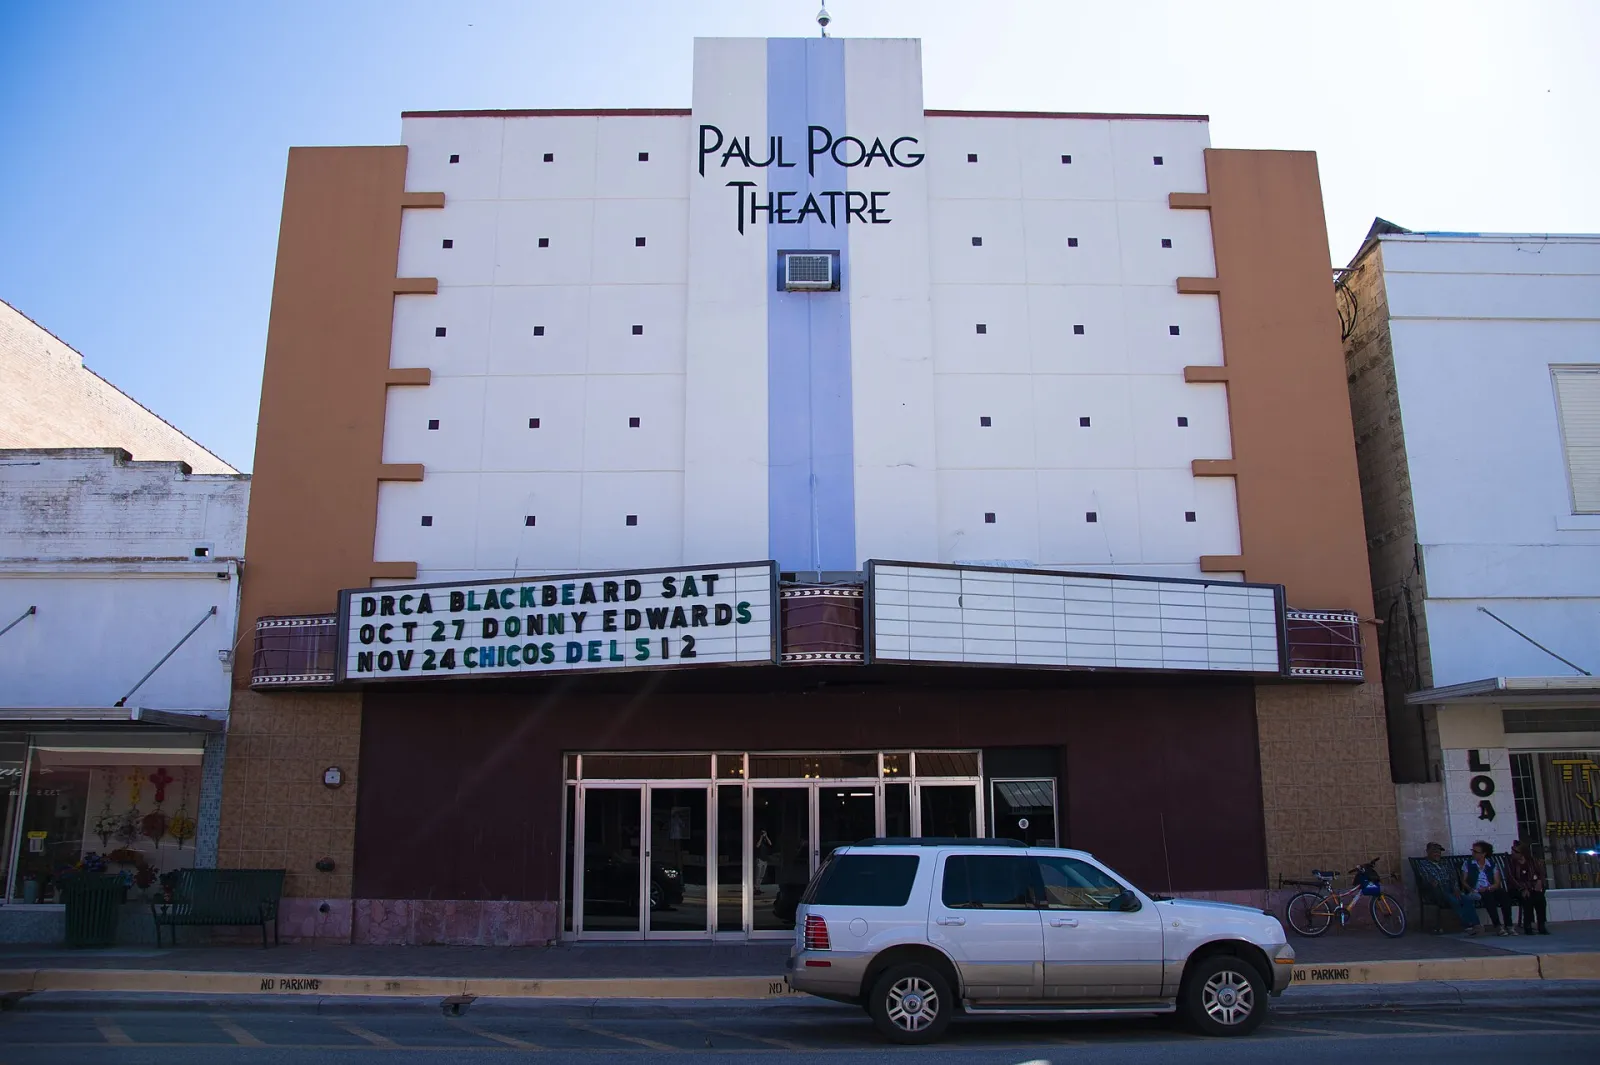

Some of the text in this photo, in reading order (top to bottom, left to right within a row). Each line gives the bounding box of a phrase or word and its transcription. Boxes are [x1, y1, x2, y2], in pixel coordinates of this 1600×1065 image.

[699, 125, 925, 178] PAUL POAG
[725, 181, 893, 235] THEATRE
[360, 573, 719, 617] DRCA BLACKBEARD SAT
[360, 601, 752, 644] OCT 27 DONNY EDWARDS
[357, 634, 697, 672] NOV 24 CHICOS DEL 512
[261, 979, 319, 990] NO PARKING
[768, 982, 782, 994] NO
[1294, 969, 1349, 980] NO PARKING
